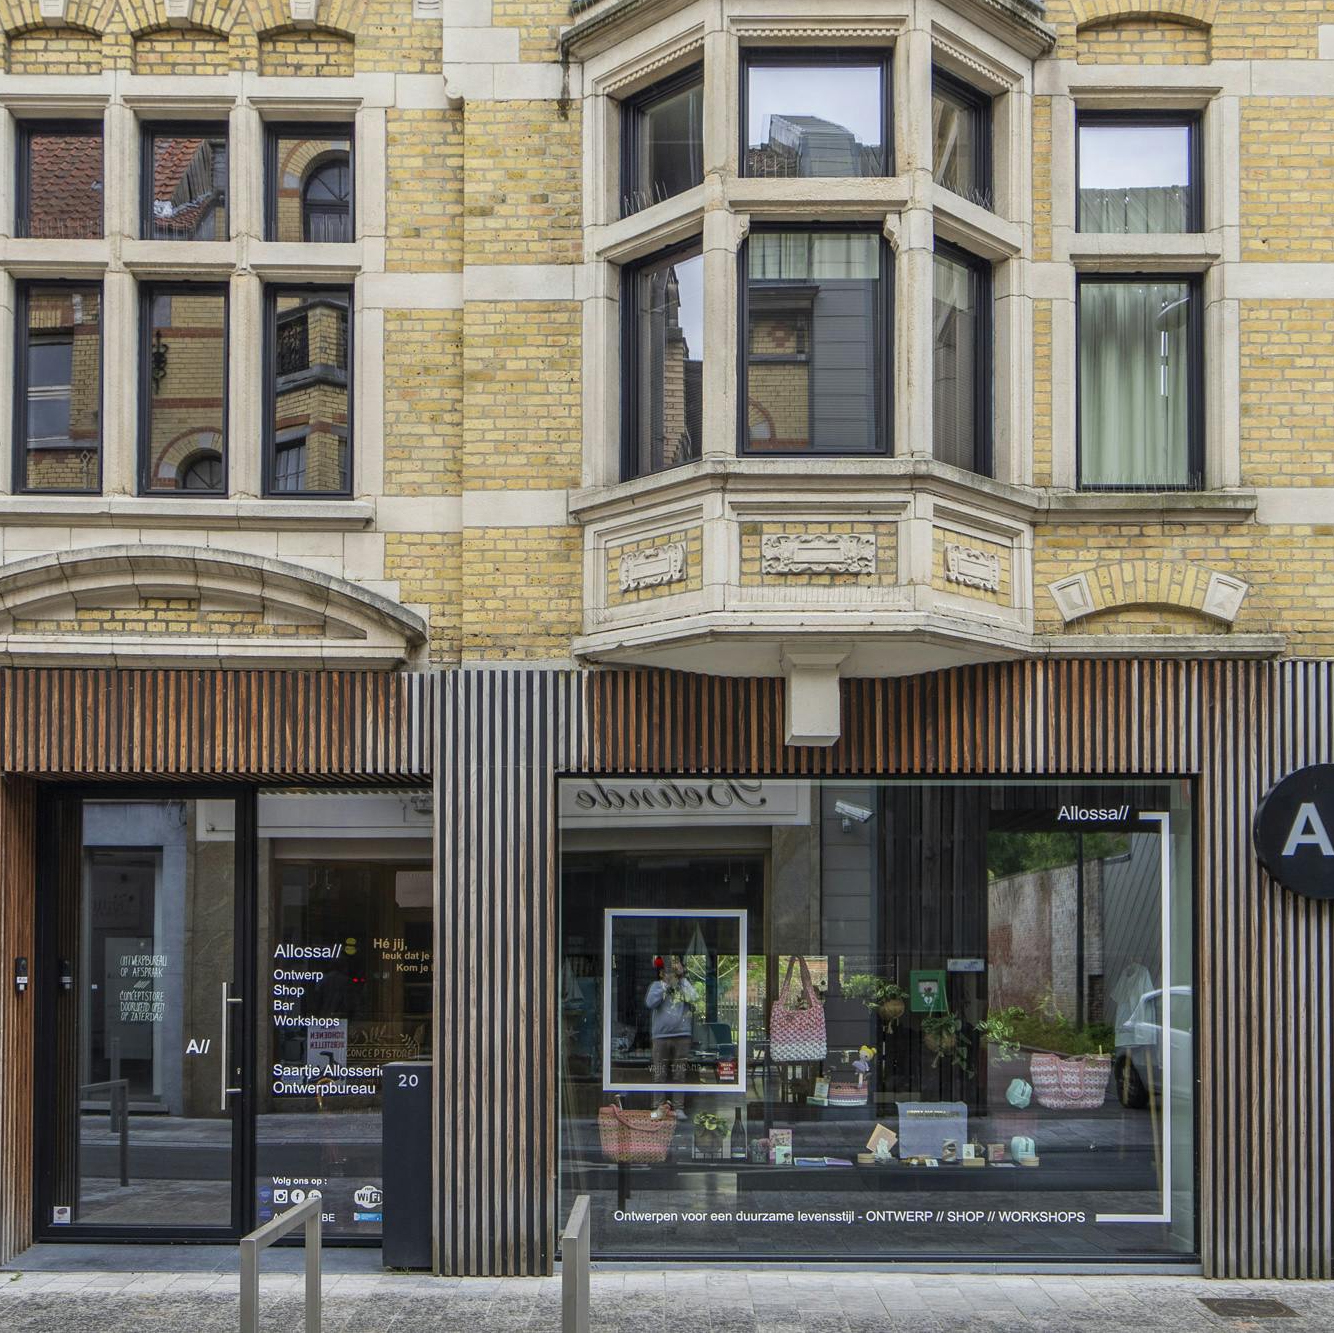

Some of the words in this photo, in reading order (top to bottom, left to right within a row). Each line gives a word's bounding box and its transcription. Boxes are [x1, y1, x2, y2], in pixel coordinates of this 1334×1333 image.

[1057, 805, 1129, 821] Allossa//
[273, 943, 342, 958] Allossa//
[373, 938, 390, 949] Hé
[393, 938, 408, 951] jij,
[382, 951, 402, 960] leuk
[404, 951, 419, 960] dat
[421, 951, 430, 961] je
[120, 967, 129, 978] OP
[132, 967, 164, 978] AFSPRAAK
[273, 969, 324, 982] Ontwerp
[396, 964, 418, 972] Kom
[419, 964, 429, 974] je
[119, 990, 164, 1002] CONCEPTSTORE
[273, 984, 305, 998] Shop
[273, 999, 295, 1011] Bar
[130, 1012, 164, 1022] ZATERDAG
[273, 1015, 340, 1028] Workshops
[185, 1039, 211, 1054] A//
[273, 1064, 321, 1079] Saartje
[397, 1074, 419, 1087] 20
[273, 1081, 376, 1096] Ontwerpbureau
[272, 1176, 291, 1186] Volg
[311, 1178, 322, 1186] op
[357, 1192, 381, 1202] WiFi
[614, 1211, 678, 1223] Ontwerpen
[681, 1213, 708, 1222] voor
[710, 1213, 733, 1222] een
[736, 1211, 794, 1222] duurzame
[797, 1211, 854, 1224] levensstijl
[865, 1211, 933, 1222] ONTWERP
[947, 1211, 985, 1222] SHOP
[998, 1211, 1086, 1223] WORKSHOPS
